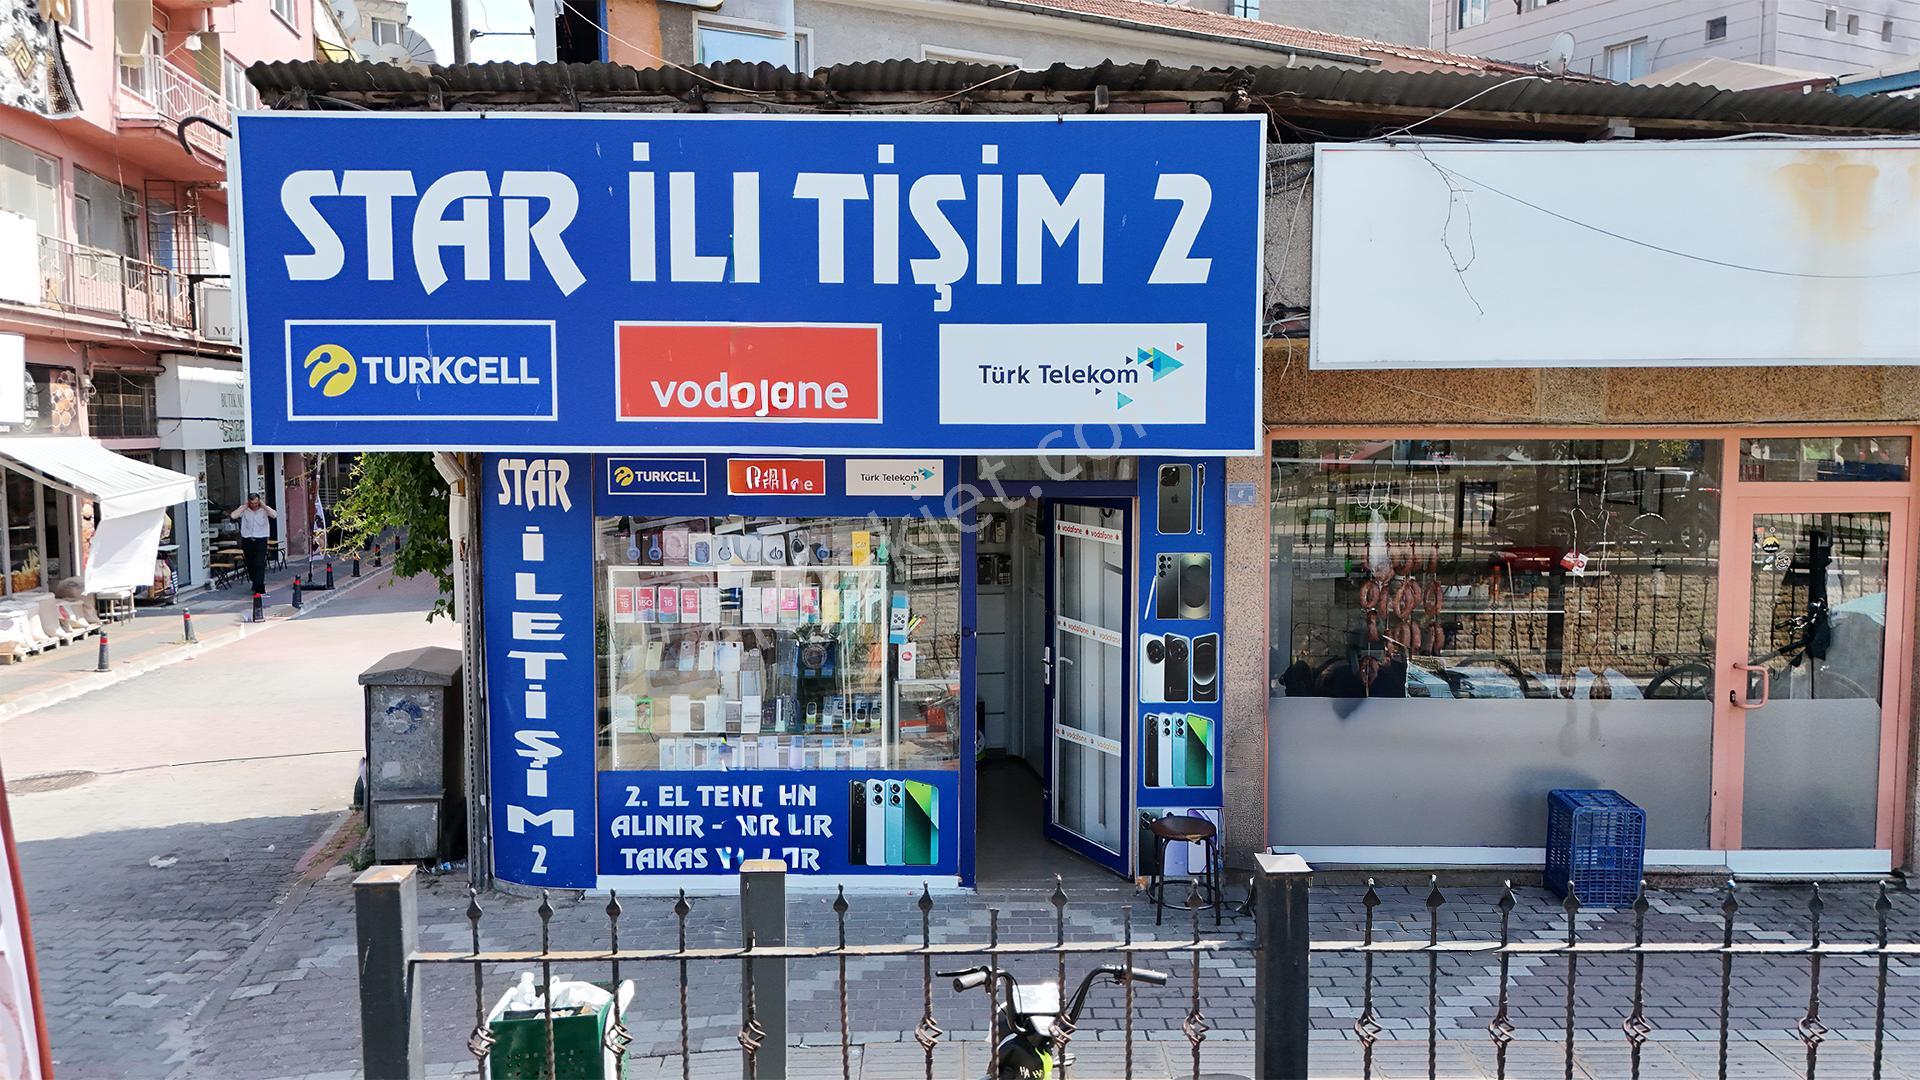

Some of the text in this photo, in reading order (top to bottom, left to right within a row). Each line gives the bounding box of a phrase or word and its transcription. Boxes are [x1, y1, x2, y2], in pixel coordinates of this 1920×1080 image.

[281, 169, 587, 296] STAR
[1148, 173, 1213, 284] 2
[363, 356, 540, 385] TURKCELL
[978, 363, 1139, 385] Türk Telekom
[497, 458, 572, 513] STAR
[635, 471, 701, 484] TURKCELL
[860, 472, 920, 482] Türk Telekom
[625, 785, 648, 807] 2.
[658, 785, 690, 807] EL
[611, 814, 704, 839] ALINIR
[531, 844, 548, 874] 2
[620, 847, 708, 871] TAKAS
